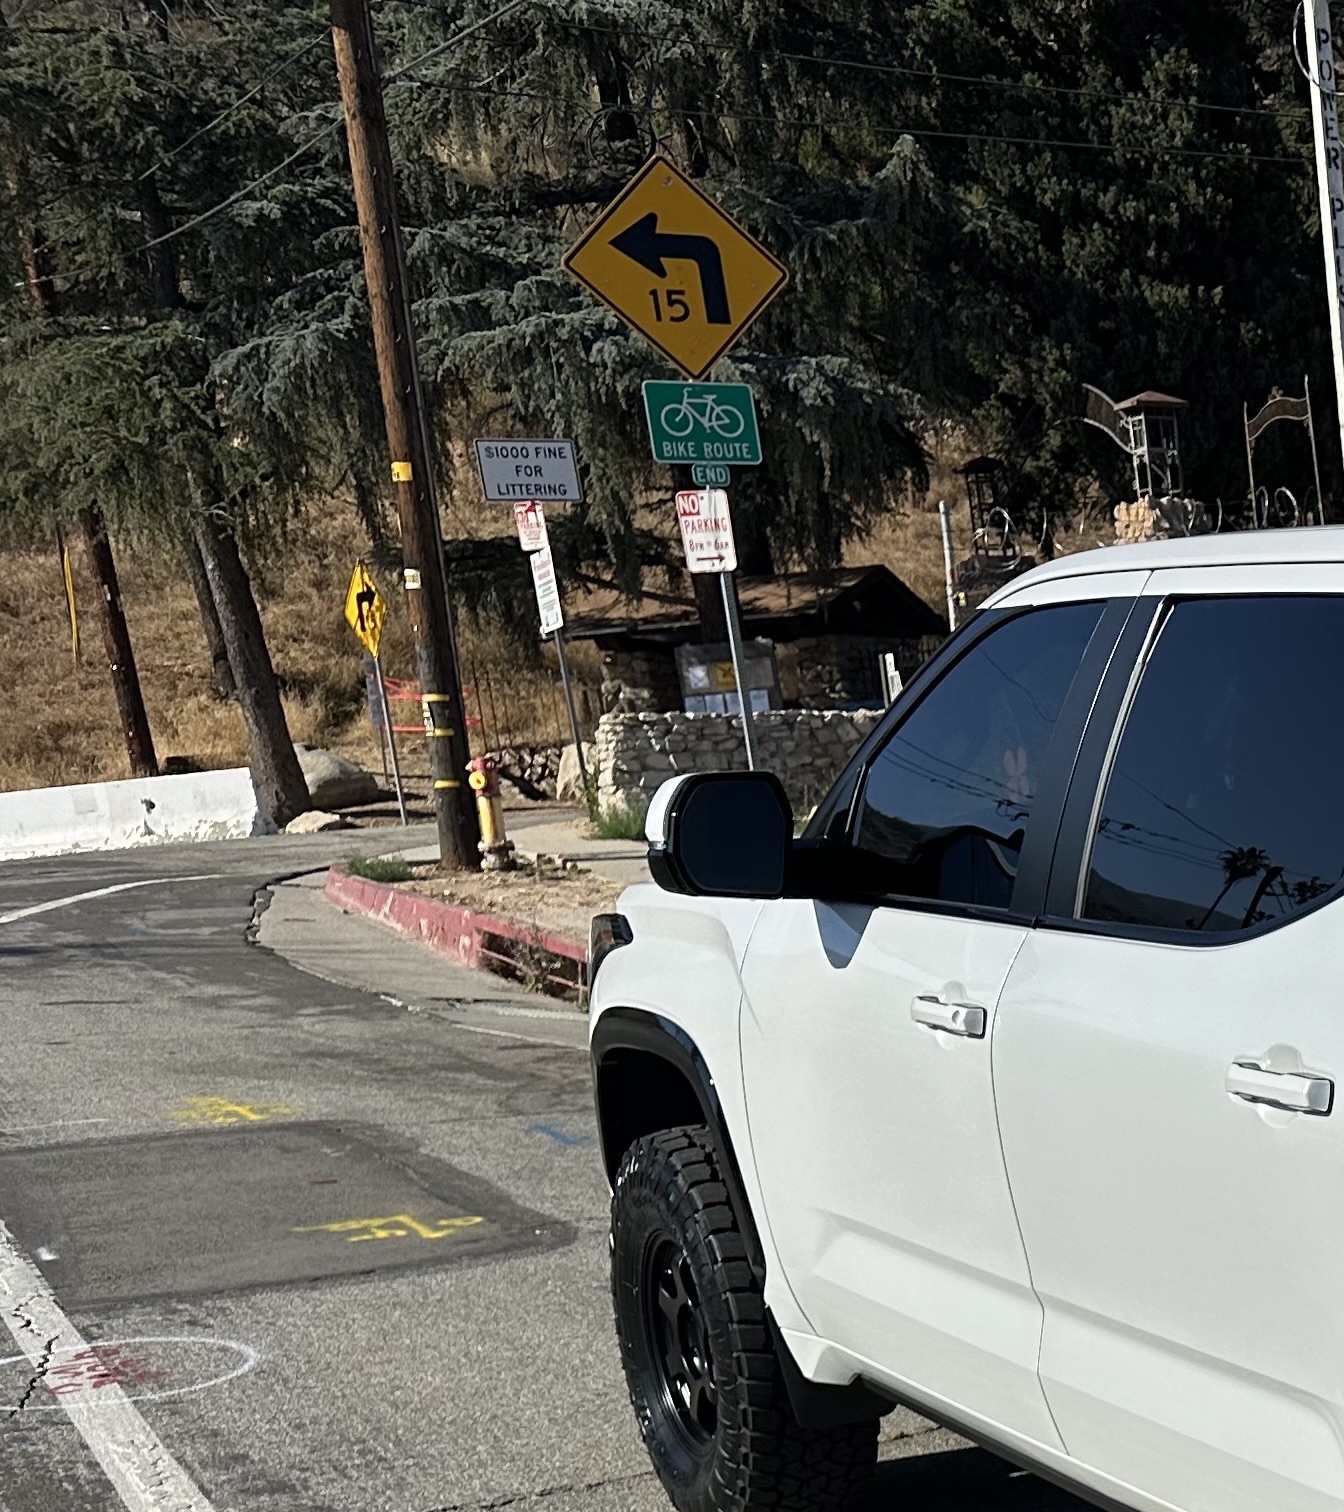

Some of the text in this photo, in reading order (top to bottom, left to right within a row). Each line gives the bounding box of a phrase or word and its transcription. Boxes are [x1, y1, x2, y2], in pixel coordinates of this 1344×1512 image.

[1317, 27, 1340, 170] POWER
[648, 288, 690, 323] 15
[484, 446, 568, 459] $1000 FINE
[662, 441, 752, 459] BIKE ROUTE
[514, 464, 544, 478] FOR
[695, 466, 726, 483] END
[496, 483, 568, 497] LITTERING
[678, 494, 700, 514] NO
[683, 517, 728, 535] PARKING
